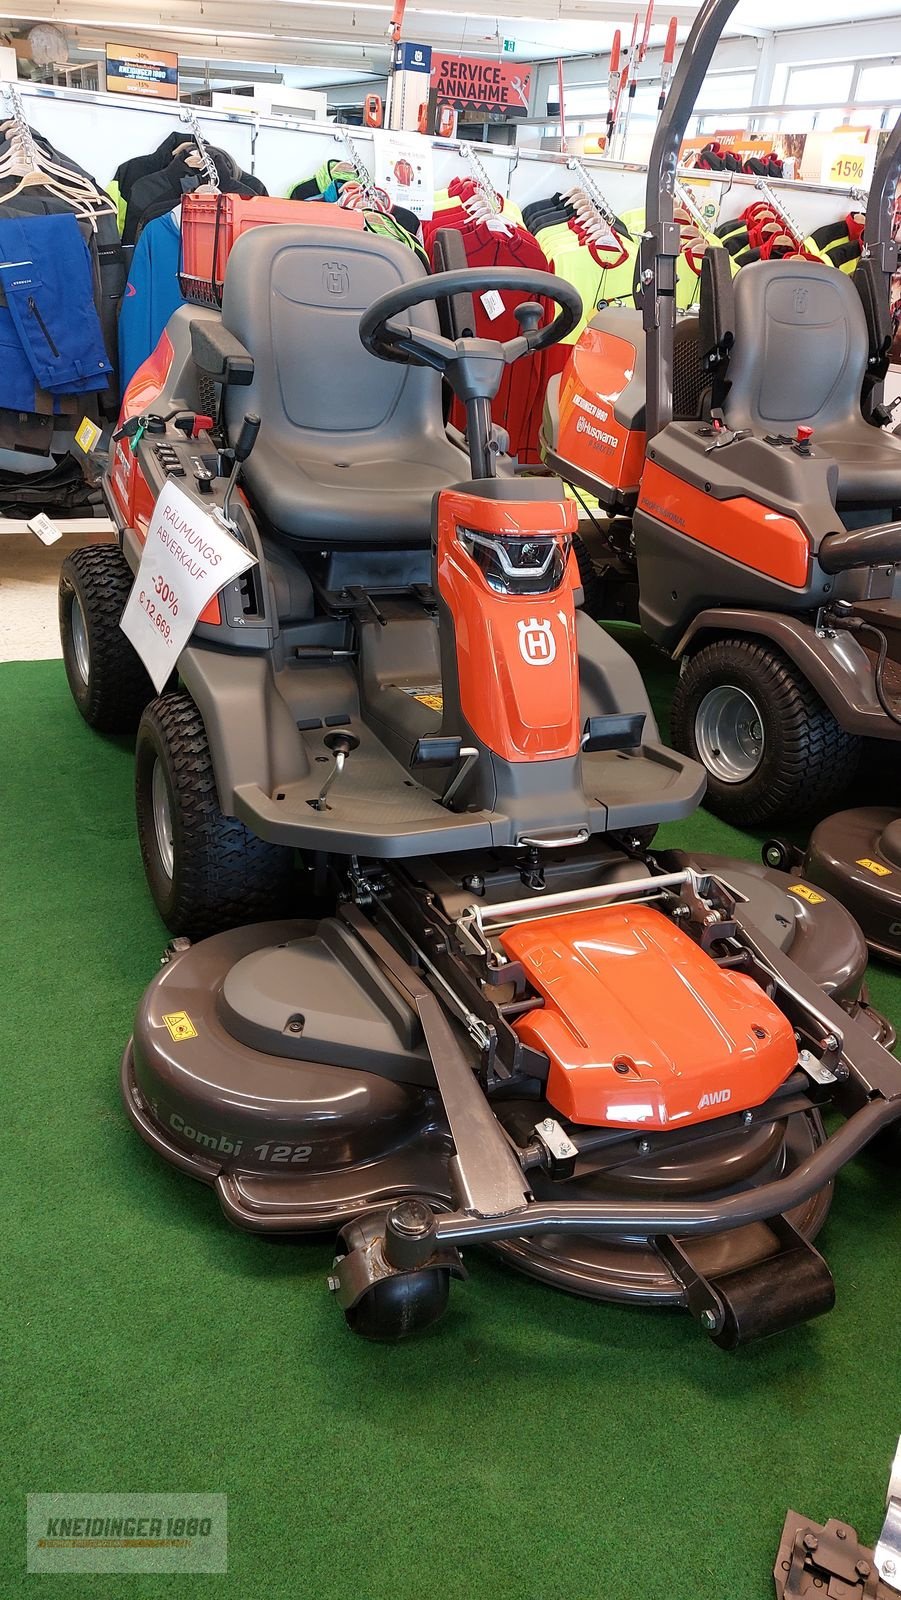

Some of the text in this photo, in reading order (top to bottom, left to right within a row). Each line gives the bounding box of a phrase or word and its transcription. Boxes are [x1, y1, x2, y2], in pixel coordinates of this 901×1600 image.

[440, 60, 506, 85] SERVICE-
[436, 78, 508, 103] ANNAHME
[715, 135, 736, 145] STIHL
[831, 160, 864, 178] -15%
[582, 420, 619, 449] Husqvarna
[162, 504, 223, 567] RÄUMUNGS
[156, 524, 208, 582] ABVERKAUF
[138, 590, 146, 604] €
[151, 574, 179, 617] -30%
[697, 1089, 731, 1110] AWD
[169, 1113, 312, 1163] Combi 122
